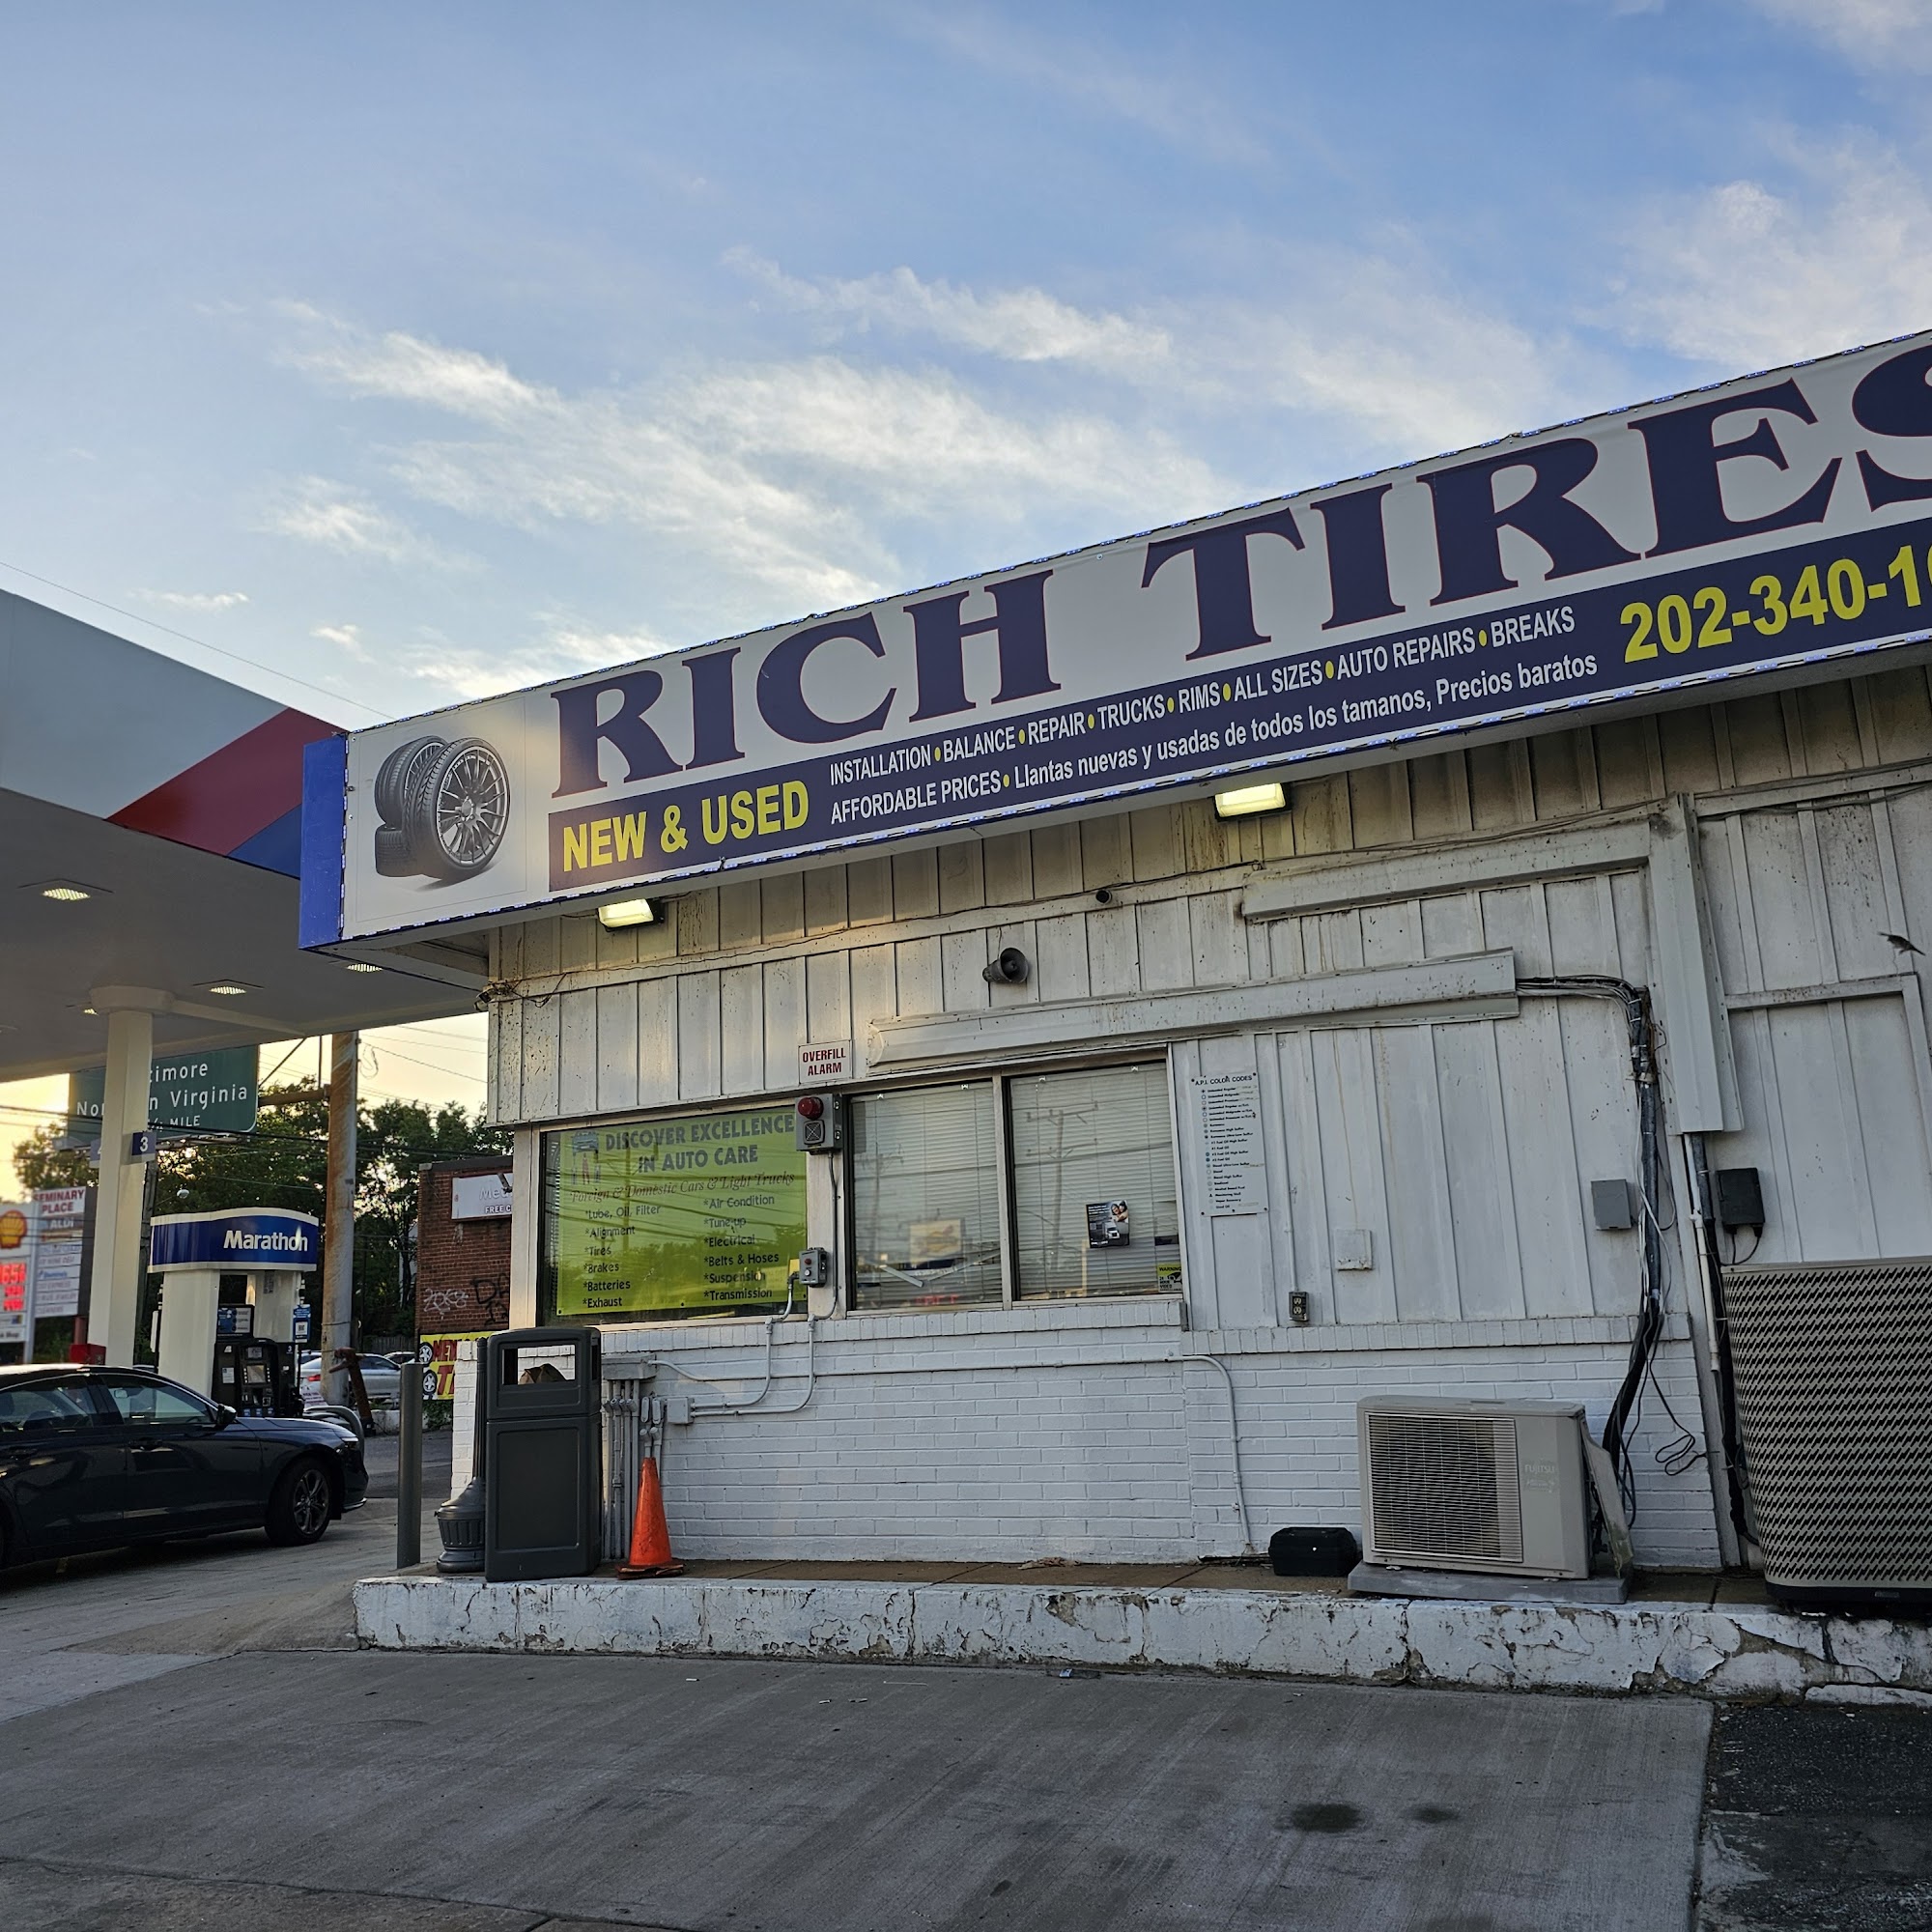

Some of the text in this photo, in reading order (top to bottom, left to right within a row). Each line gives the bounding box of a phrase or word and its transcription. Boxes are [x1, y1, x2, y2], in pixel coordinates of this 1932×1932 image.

[1620, 544, 1932, 664] 202-340-1
[550, 568, 1062, 799] RICH
[830, 606, 1576, 786] INSTALLATION BALANCE REPAIR TRUCKS RIMS ALL SIZES AUTO REPAIRS BREAKS
[831, 654, 1598, 825] AFFORDABLE PRICES Llantas nuevas y usadas de todos los tamanos, Precios baratos
[563, 780, 810, 872] NEW & USED
[803, 1047, 846, 1063] OVERFILL
[808, 1062, 841, 1076] ALARM
[171, 1084, 247, 1110] Virginia
[170, 1115, 201, 1128] MILE
[606, 1114, 795, 1151] DISCOVER EXCELLENCE
[139, 1137, 149, 1152] 3
[639, 1145, 758, 1173] IN AUTO CARE
[571, 1187, 609, 1203] Foreign
[625, 1182, 676, 1198] Domestic
[680, 1179, 704, 1193] Cars
[707, 1178, 717, 1190] &
[720, 1175, 751, 1191] Light
[753, 1171, 795, 1186] Trucks
[42, 1202, 73, 1213] PLACE
[486, 1205, 503, 1213] FREE
[636, 1205, 662, 1215] Filter
[726, 1195, 775, 1208] Condition
[223, 1230, 308, 1252] Marathon
[737, 1254, 745, 1264] &
[748, 1253, 779, 1264] Hoses
